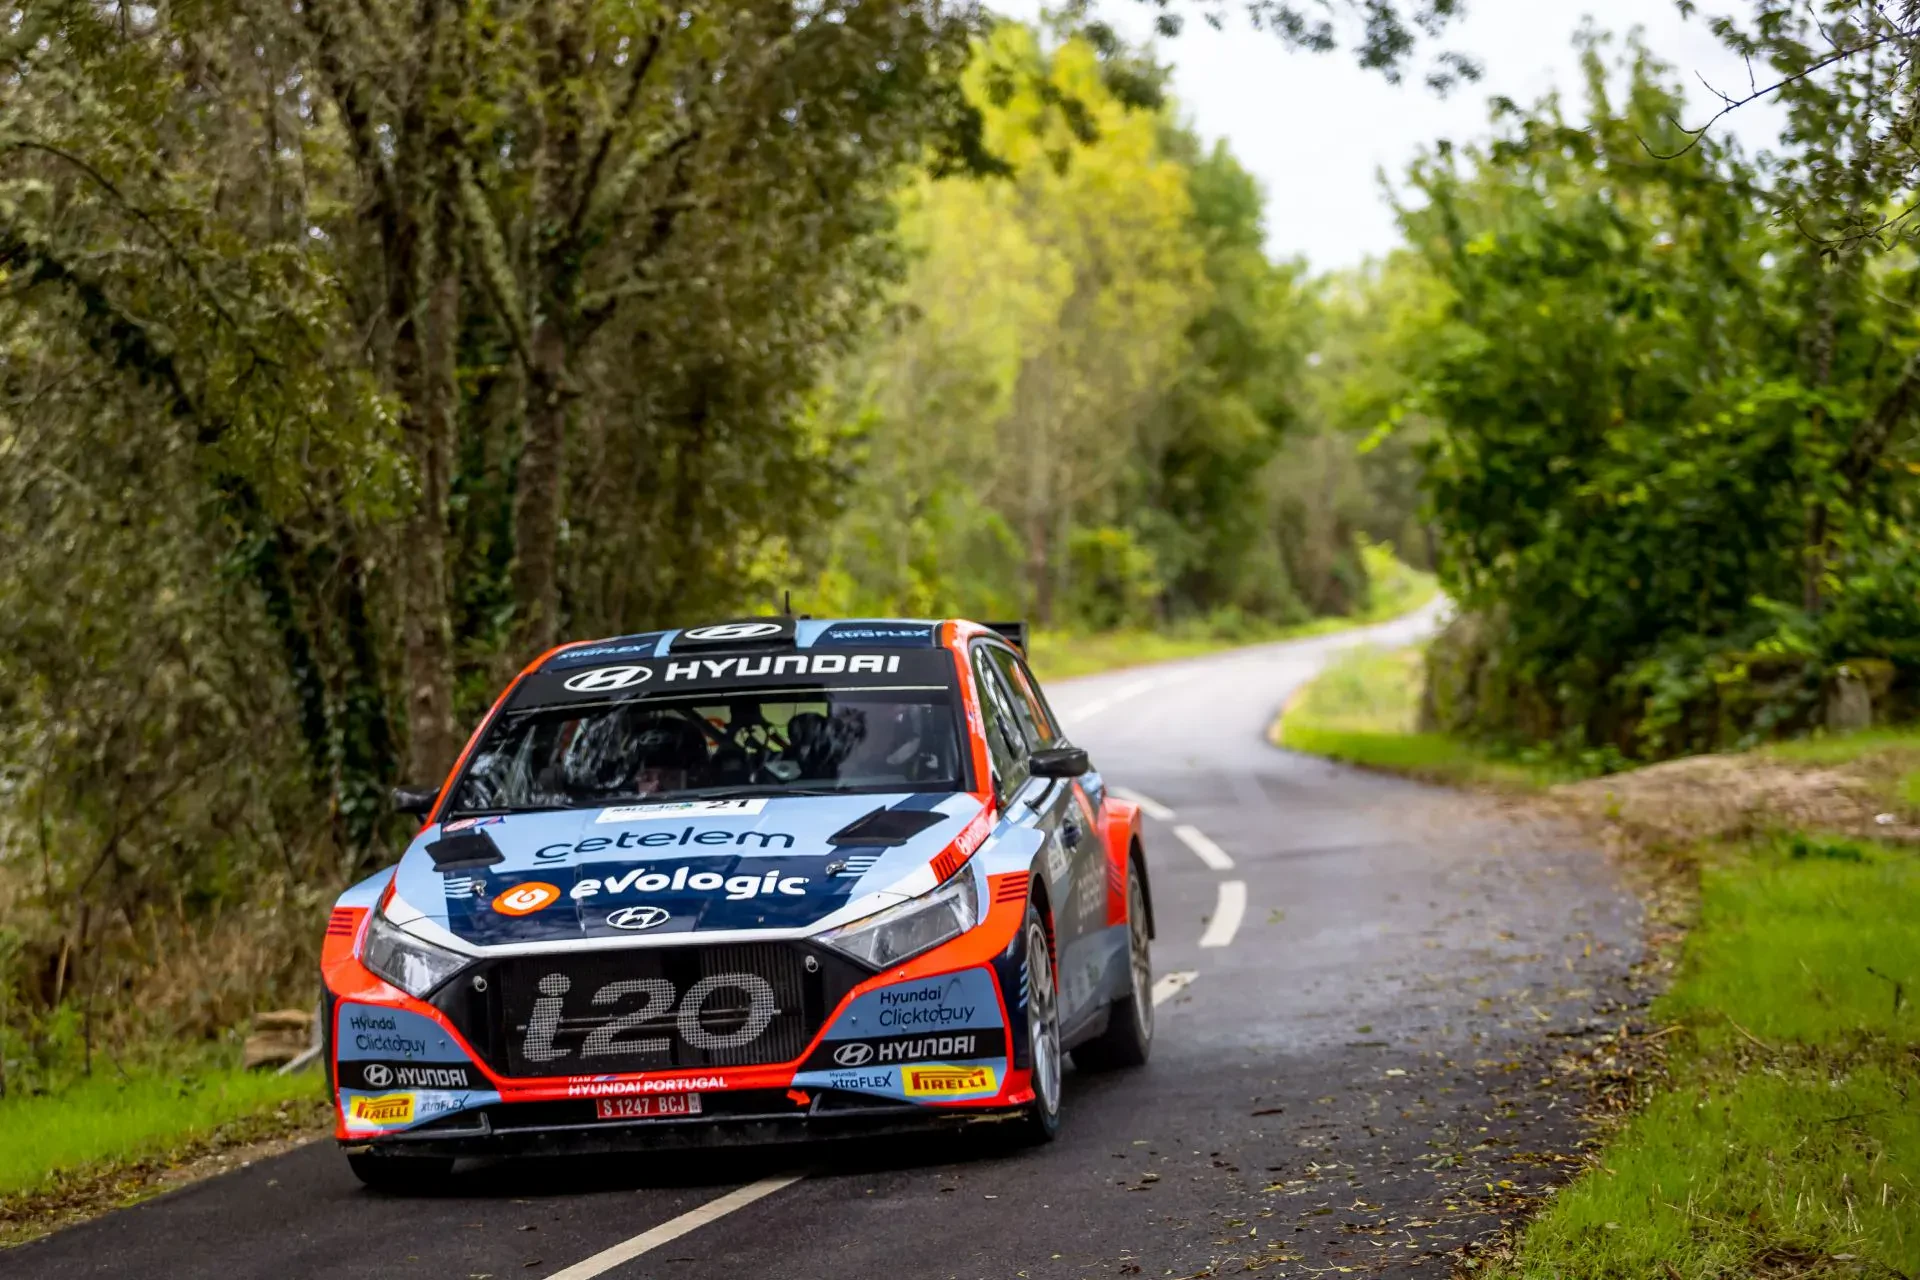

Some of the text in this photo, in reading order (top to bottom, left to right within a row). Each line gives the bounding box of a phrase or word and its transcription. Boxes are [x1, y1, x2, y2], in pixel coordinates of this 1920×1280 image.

[665, 654, 900, 682] HYUNDAI
[706, 800, 750, 809] 21
[514, 826, 795, 865] cetelem
[570, 866, 810, 900] evologic
[879, 986, 941, 1006] Hyundai
[350, 1016, 396, 1032] Hyundai
[522, 973, 774, 1062] i20
[879, 1036, 976, 1061] HYUNDAI
[395, 1067, 469, 1087] HYUNDAI
[568, 1076, 728, 1096] HYUNDAI PORTUGAL
[832, 1071, 892, 1089] xtraFLEX
[911, 1070, 987, 1091] PIRELLI
[356, 1098, 410, 1119] PIRELLI
[603, 1100, 613, 1116] S
[618, 1097, 650, 1116] 1247
[658, 1095, 685, 1113] BCJ
